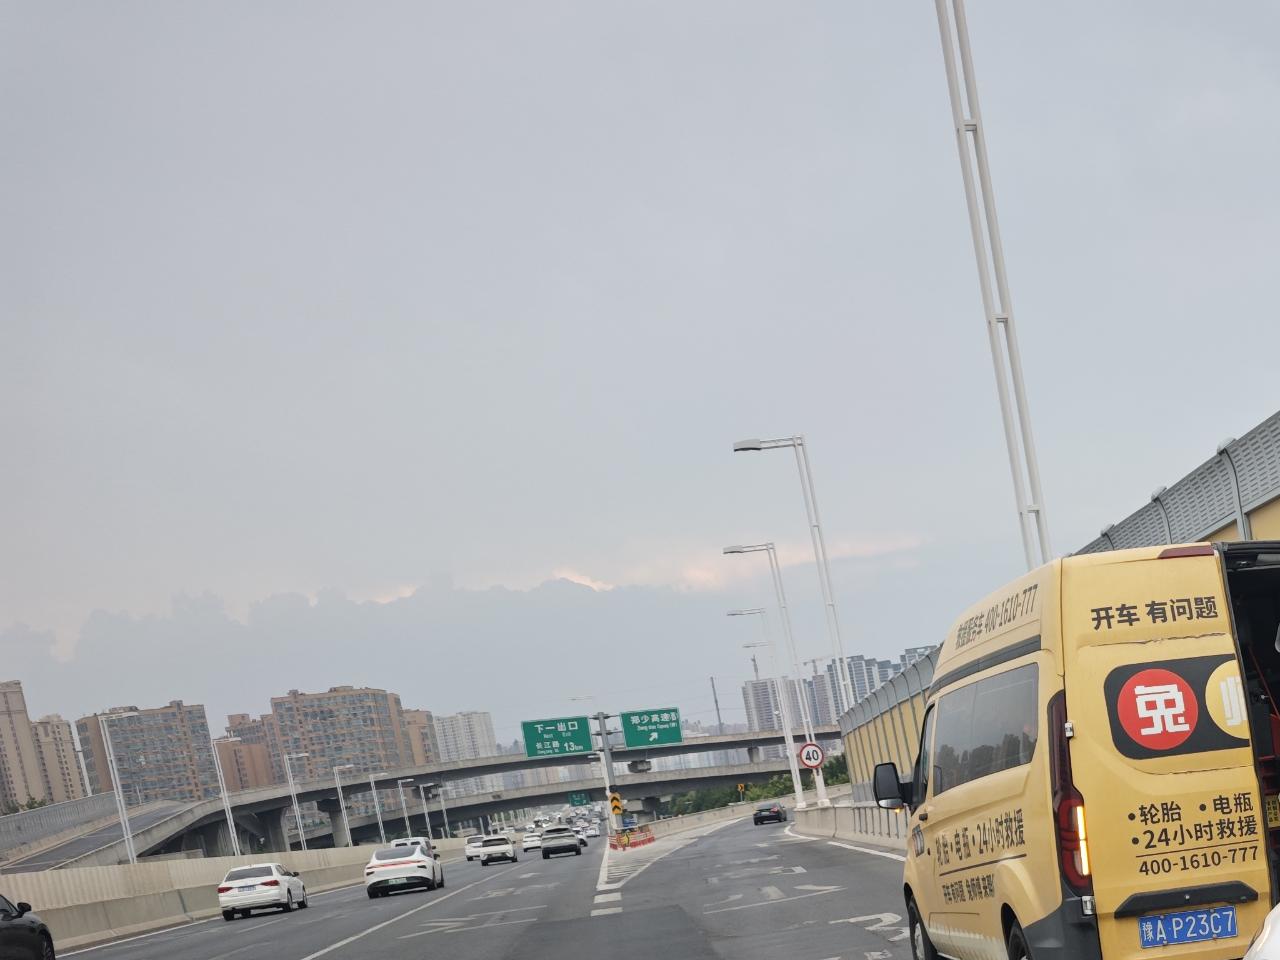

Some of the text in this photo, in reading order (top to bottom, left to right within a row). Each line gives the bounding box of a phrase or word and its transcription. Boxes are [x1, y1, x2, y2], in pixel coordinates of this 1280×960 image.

[985, 584, 1038, 634] 400-1610-777
[1091, 596, 1219, 631] 开车 有问题
[534, 721, 578, 734] 下一出口
[805, 749, 819, 761] 40
[1138, 801, 1182, 826] 轮胎
[1213, 792, 1254, 815] 电瓶
[1143, 815, 1258, 850] 24小时救援
[1139, 846, 1258, 876] 400-1610-777
